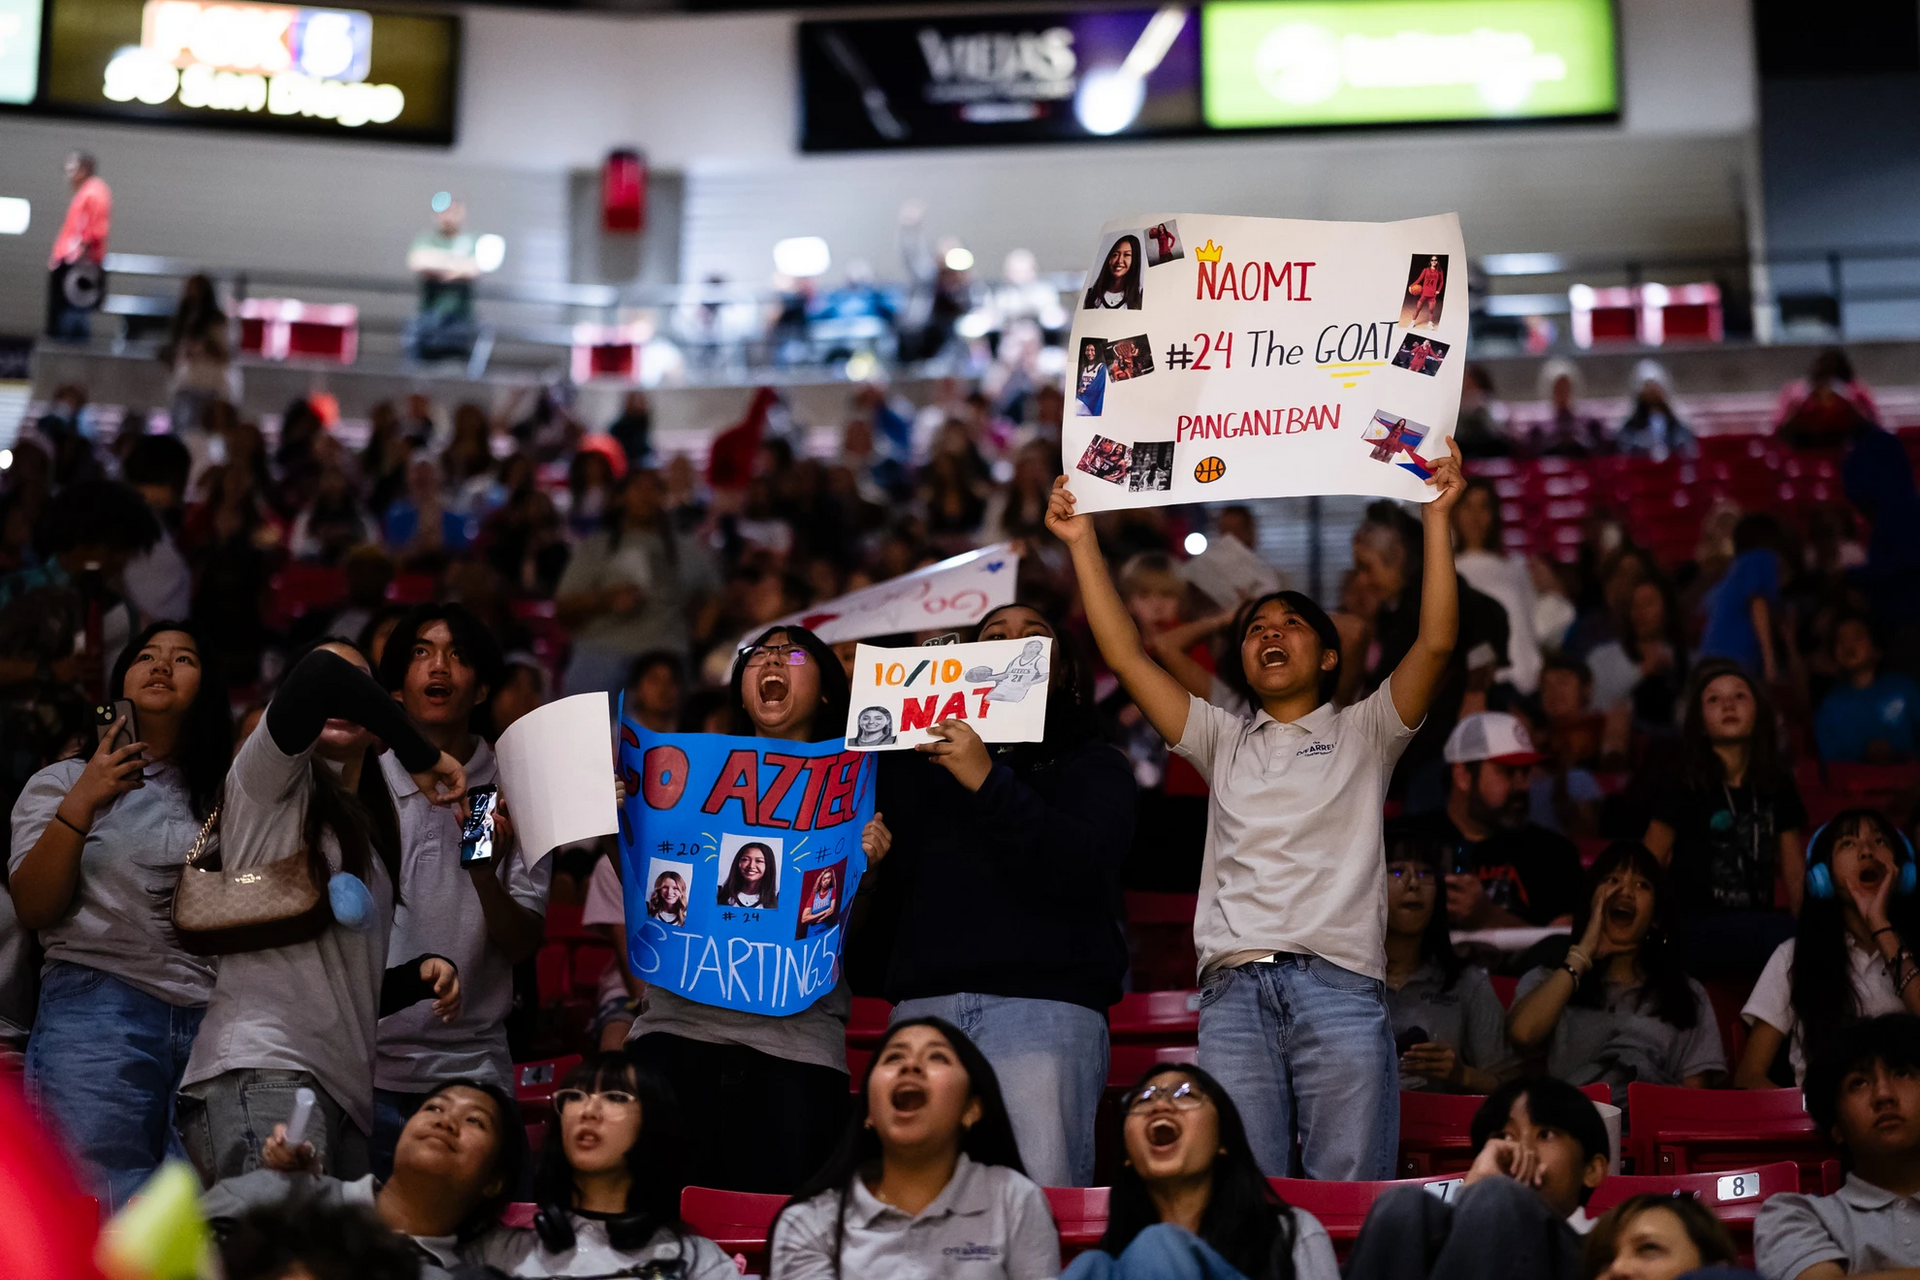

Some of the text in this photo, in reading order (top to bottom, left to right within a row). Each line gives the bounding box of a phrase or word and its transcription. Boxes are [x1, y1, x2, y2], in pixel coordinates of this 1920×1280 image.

[1196, 262, 1316, 301] NAOMI
[1165, 321, 1400, 371] #24 The GOAT
[1176, 404, 1342, 443] PANGANIBAN
[875, 658, 963, 688] 10/10
[1011, 674, 1024, 683] 21
[900, 686, 994, 732] NAT
[631, 920, 822, 1008] STARTING
[1438, 1182, 1449, 1201] 7
[1733, 1176, 1744, 1196] 8
